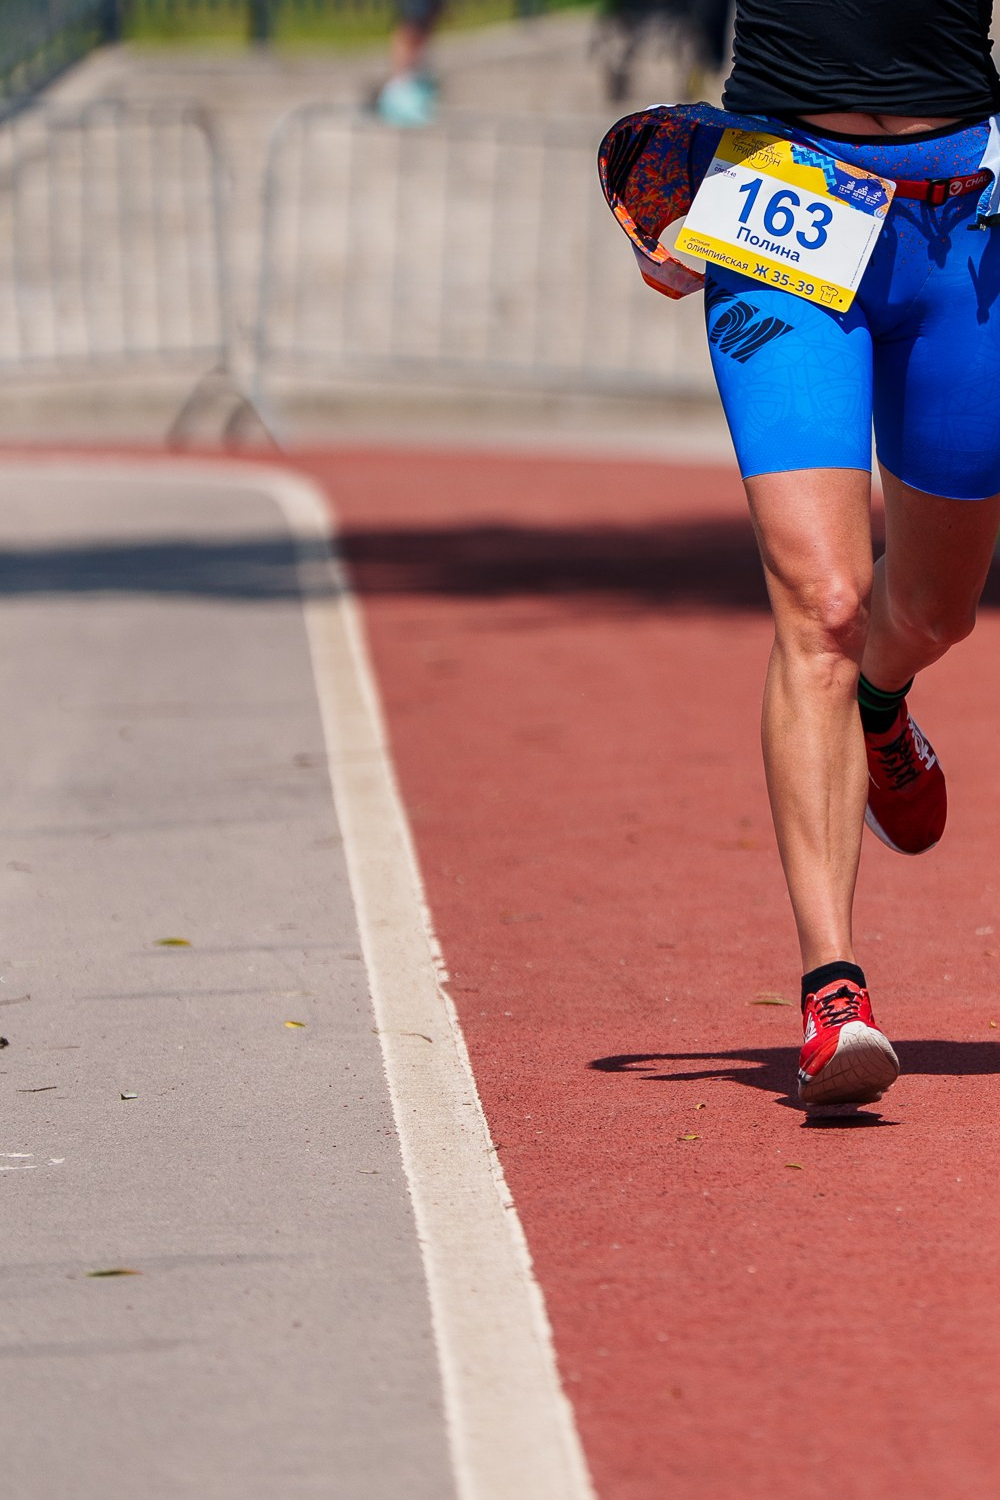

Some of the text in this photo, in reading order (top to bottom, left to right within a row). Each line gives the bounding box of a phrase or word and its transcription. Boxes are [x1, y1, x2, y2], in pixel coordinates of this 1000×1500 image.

[738, 177, 833, 250] 163
[687, 242, 815, 295] ОЛИМПИЙСКАЯ Ж 35-39
[736, 226, 801, 263] Полина
